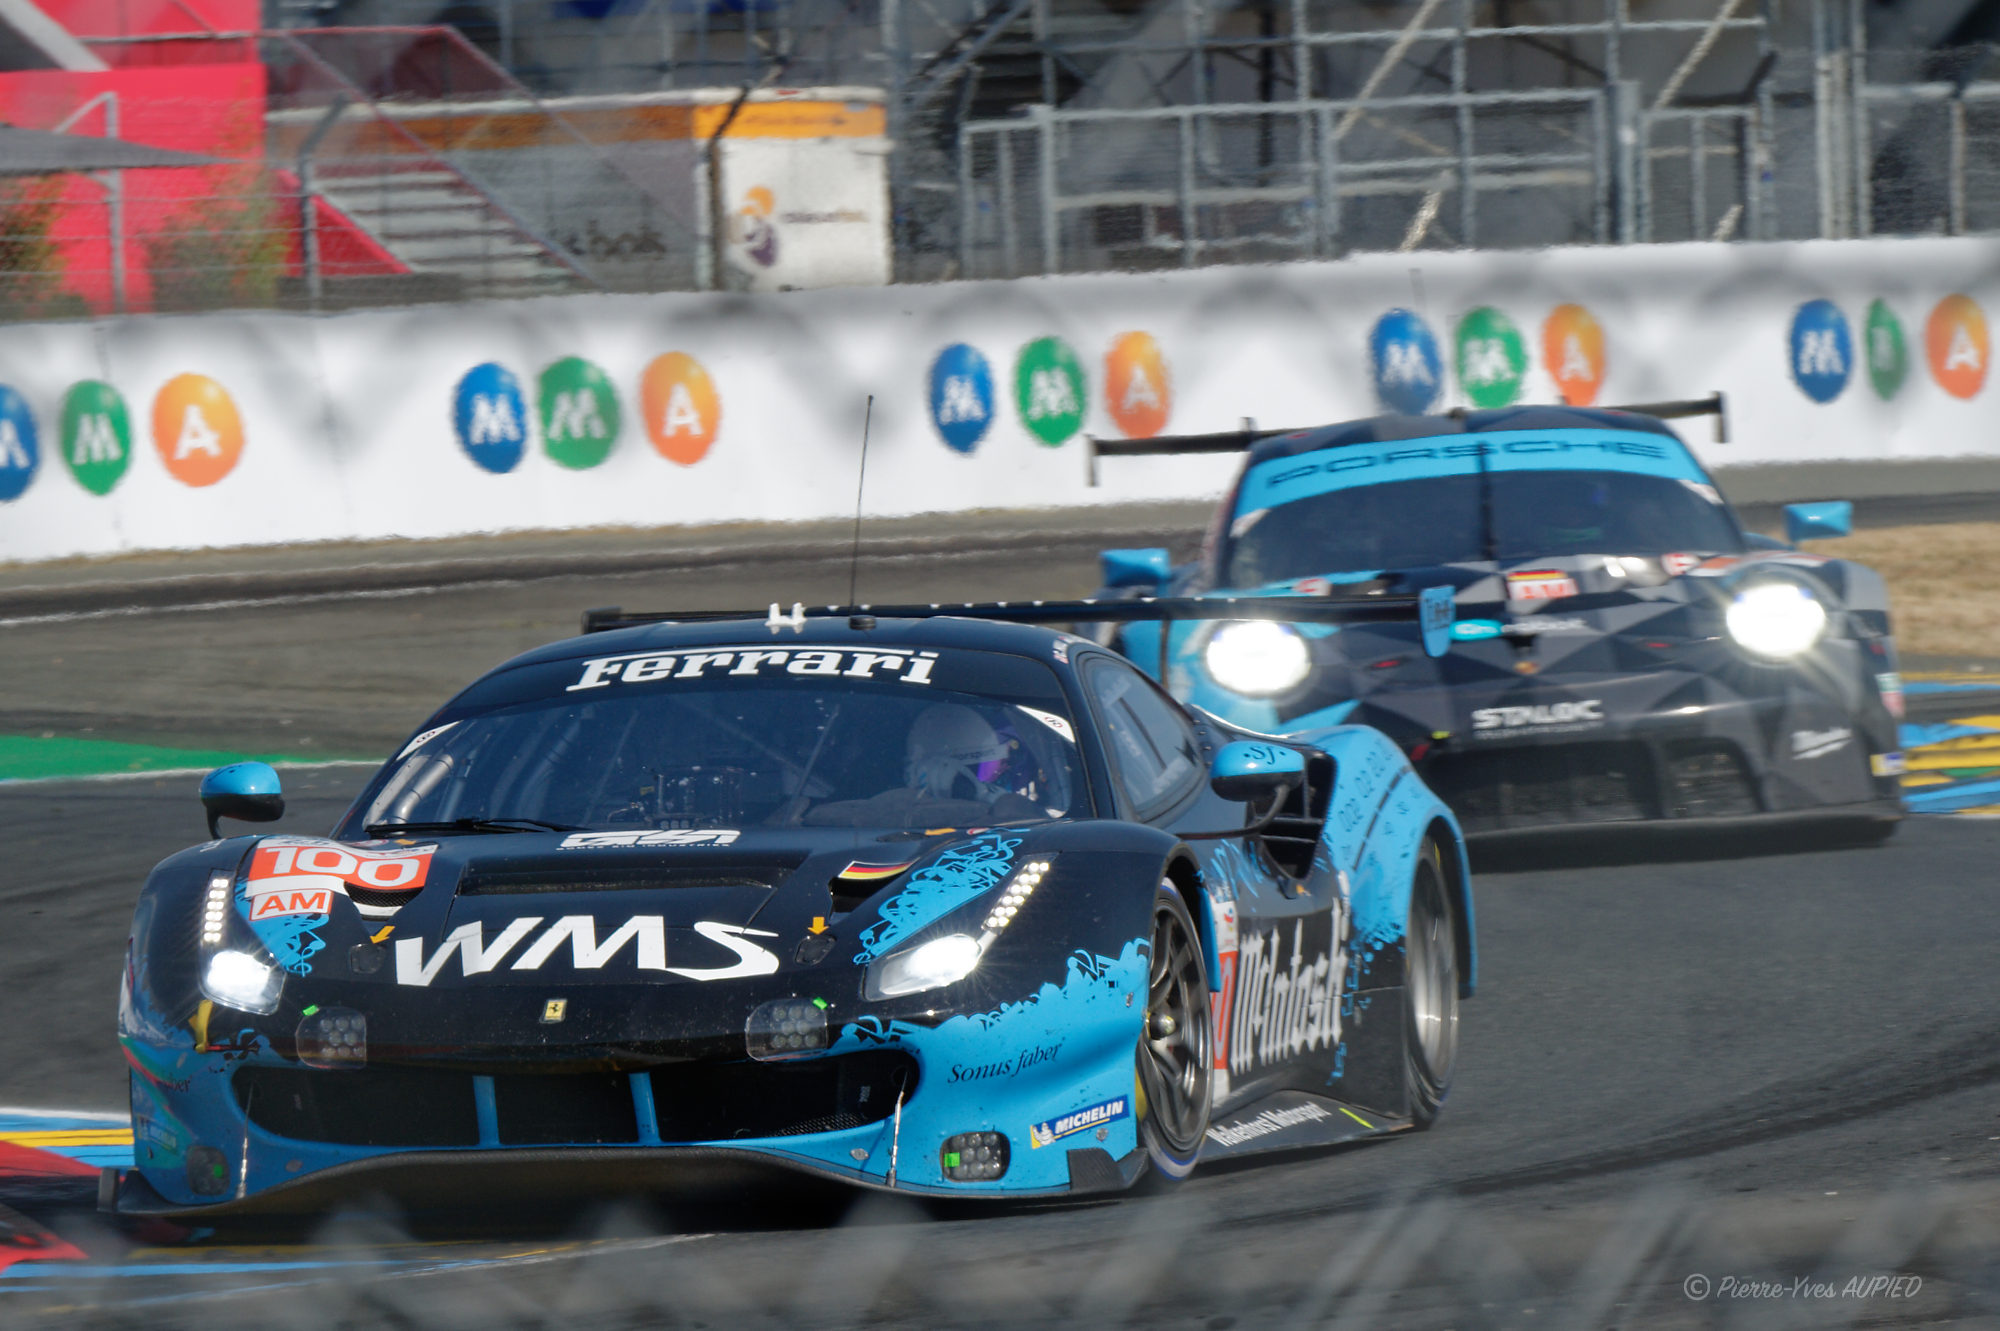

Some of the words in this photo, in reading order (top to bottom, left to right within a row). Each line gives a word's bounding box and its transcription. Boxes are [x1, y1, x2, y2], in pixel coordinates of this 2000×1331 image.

[1266, 438, 1669, 489] PORSCHE
[566, 646, 939, 691] Ferrari
[266, 846, 421, 888] 100
[256, 891, 327, 916] AM
[395, 914, 780, 987] WMS
[947, 1058, 1013, 1084] Sonus
[1011, 1042, 1063, 1078] faber
[1054, 1100, 1124, 1134] MICHELIN
